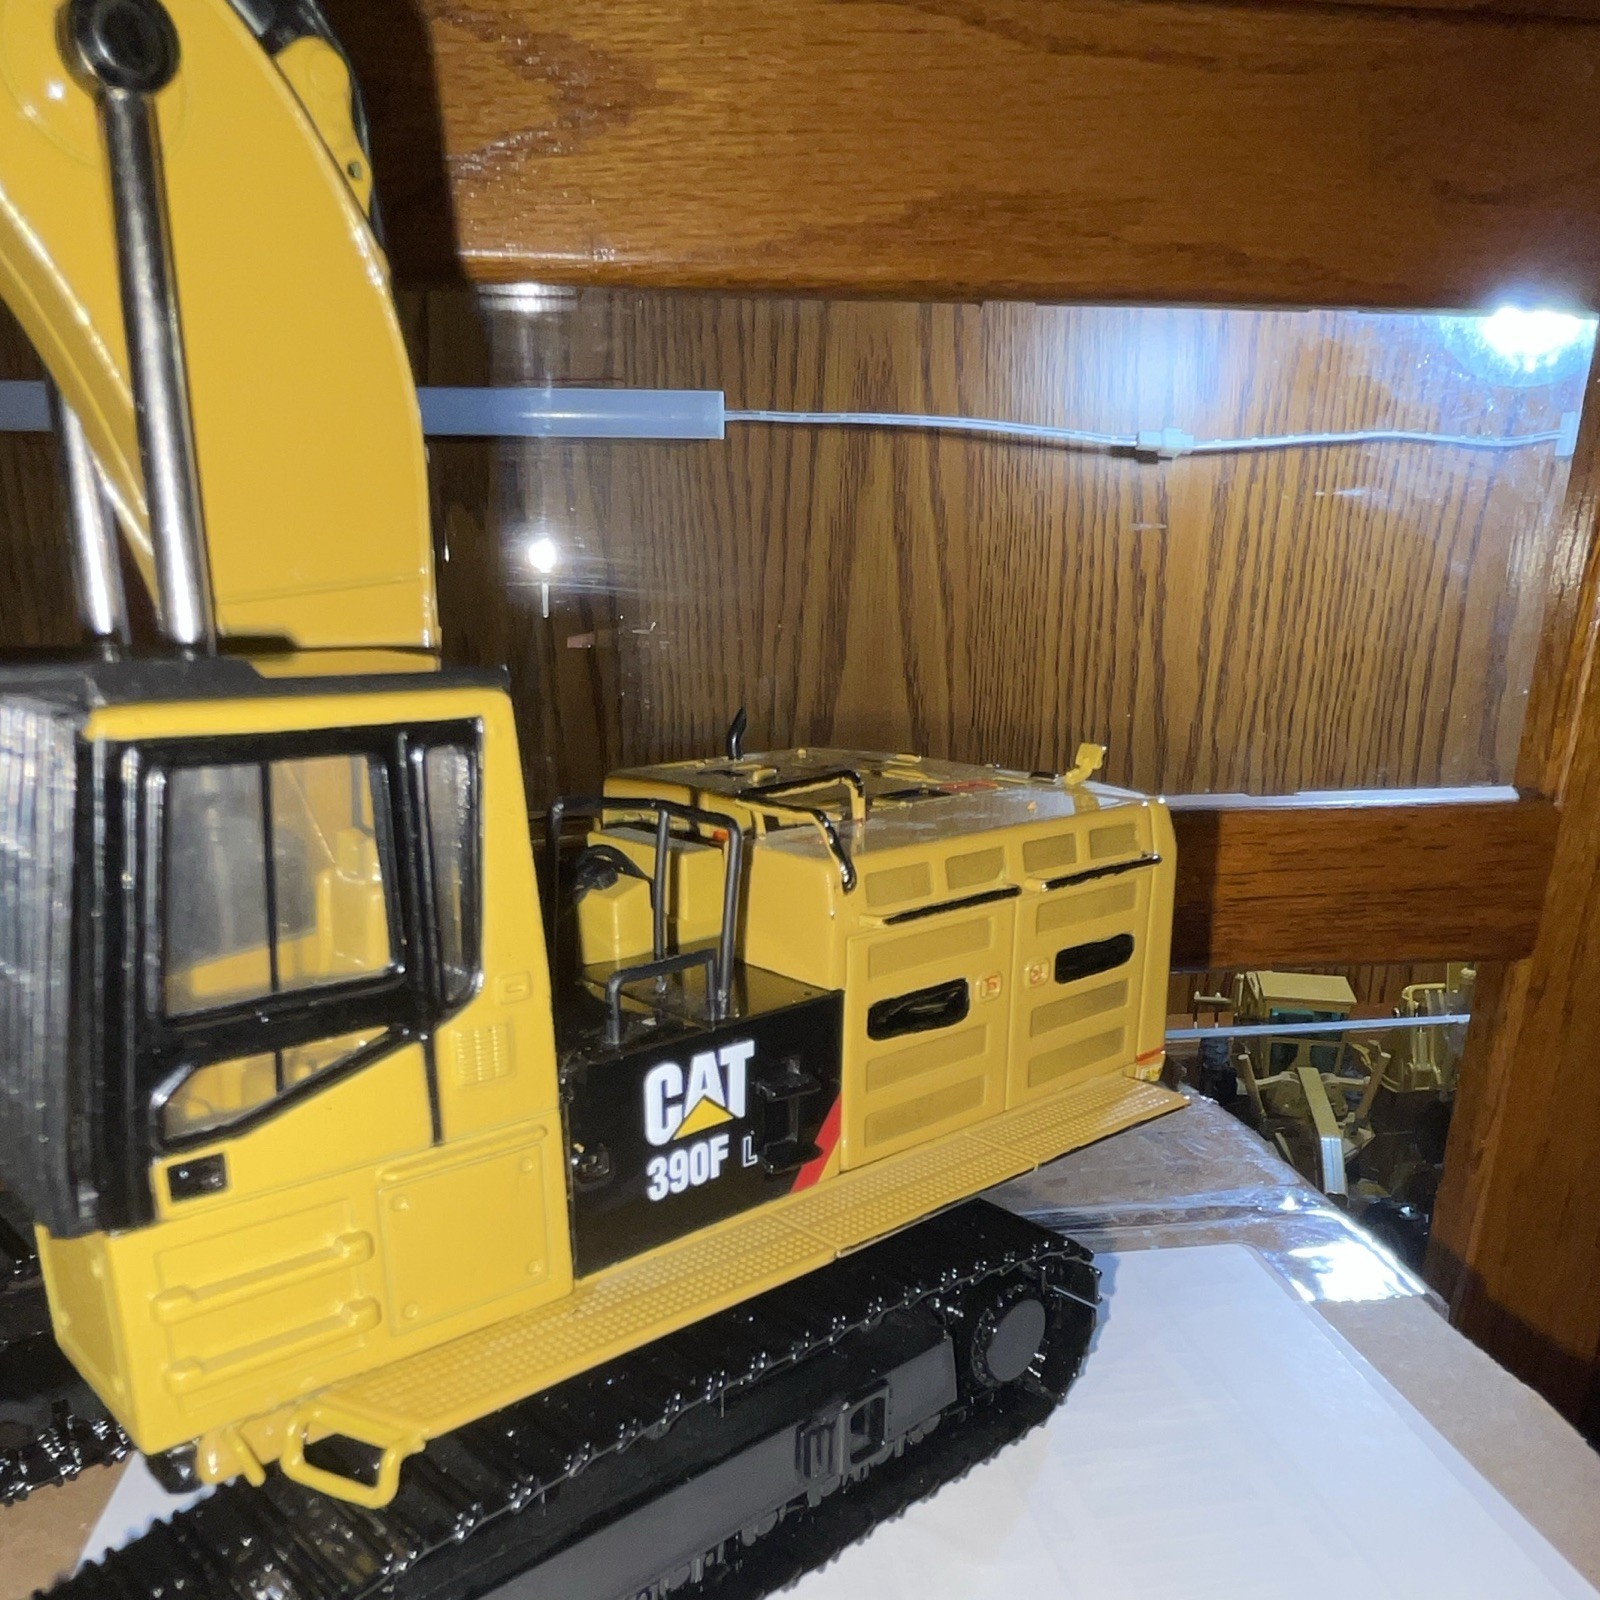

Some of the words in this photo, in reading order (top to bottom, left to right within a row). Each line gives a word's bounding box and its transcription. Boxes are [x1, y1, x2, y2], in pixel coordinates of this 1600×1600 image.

[644, 1040, 755, 1146] CAT
[646, 1134, 730, 1202] 390F
[742, 1135, 758, 1168] L
